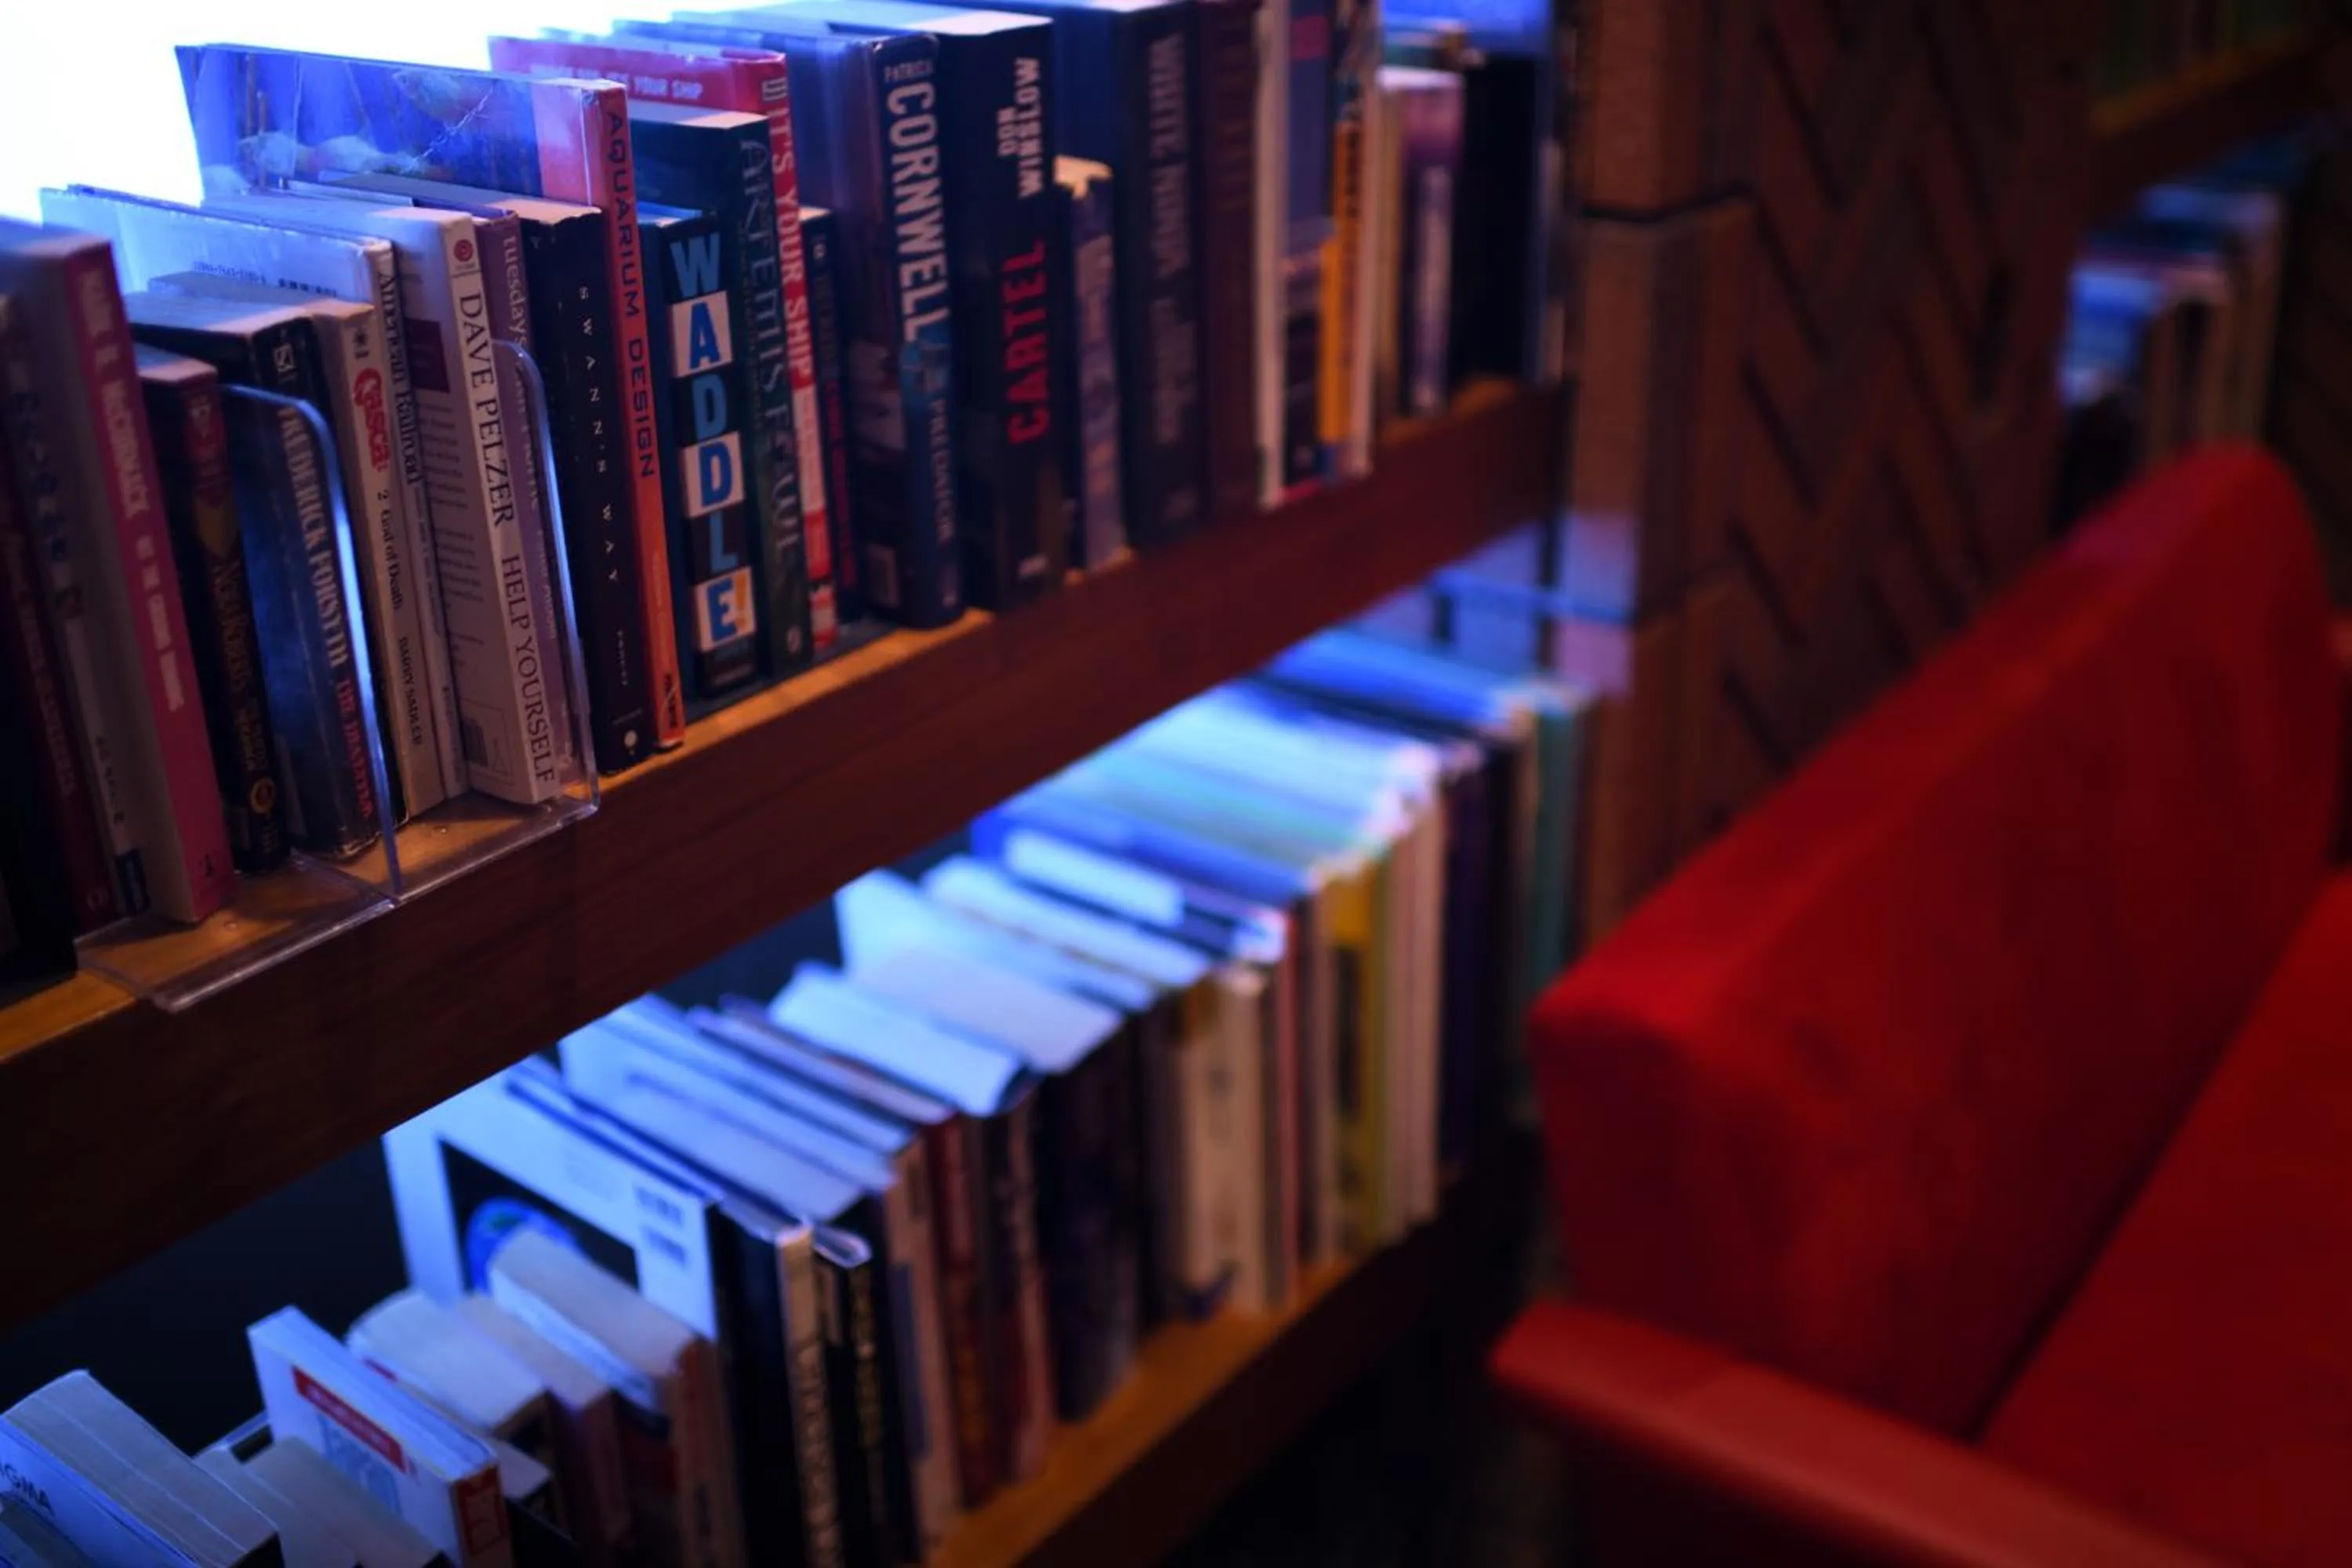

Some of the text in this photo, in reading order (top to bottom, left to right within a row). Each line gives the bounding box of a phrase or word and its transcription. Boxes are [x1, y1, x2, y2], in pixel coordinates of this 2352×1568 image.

[767, 107, 793, 175] IT'S
[997, 107, 1018, 157] DON
[1014, 57, 1044, 198] WINSLOW
[775, 193, 806, 285] YOUR
[886, 82, 951, 343] CORNWELL
[379, 272, 405, 385] American
[458, 292, 495, 389] DAVE
[503, 237, 528, 347] tuesdays
[606, 111, 655, 477] AQUARIUM DESIGN
[786, 298, 815, 384] SHIP
[1003, 240, 1047, 445] CARTEL
[475, 396, 515, 529] PELZER
[579, 285, 619, 582] SWANN'S WAY
[308, 549, 349, 669] FORSYTH
[500, 554, 533, 632] HELP
[514, 634, 556, 784] YOURSELF
